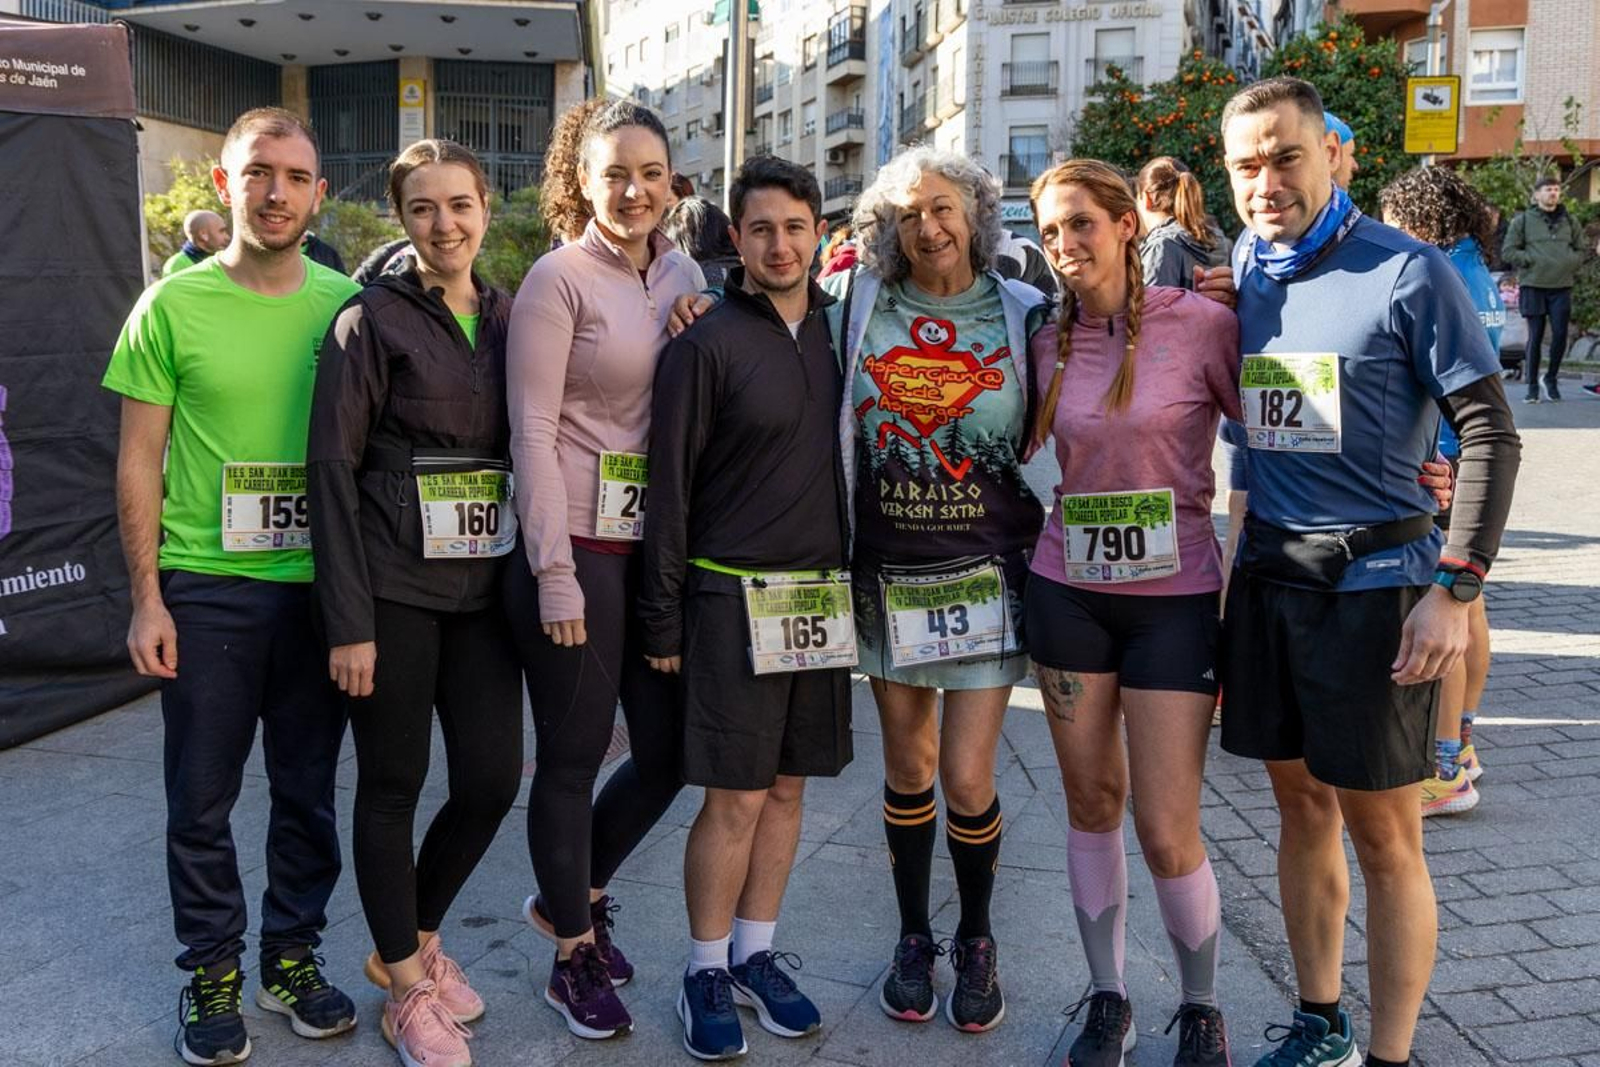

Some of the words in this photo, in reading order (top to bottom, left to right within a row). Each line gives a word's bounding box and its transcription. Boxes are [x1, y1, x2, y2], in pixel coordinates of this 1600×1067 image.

[1044, 6, 1102, 22] COLEGIO
[1108, 2, 1162, 19] OFICIAL
[12, 58, 68, 76] Municipal
[71, 64, 86, 76] de
[9, 72, 25, 85] de
[28, 74, 57, 88] Jaén
[880, 397, 973, 425] Asperger
[1259, 389, 1303, 428] 182
[248, 467, 265, 478] SAN
[267, 467, 288, 478] JUAN
[441, 474, 457, 486] SAN
[459, 474, 478, 485] JUAN
[243, 479, 275, 491] CARRERA
[438, 487, 465, 498] CARRERA
[881, 478, 982, 501] PARAISO
[881, 501, 934, 519] VIRGEN
[940, 503, 985, 519] EXTRA
[1092, 497, 1109, 509] JUAN
[1110, 495, 1133, 508] BOSCO
[259, 495, 309, 530] 159
[455, 502, 499, 537] 160
[1099, 507, 1129, 521] POPULAR
[895, 521, 925, 532] TIENDA
[1083, 525, 1146, 562] 790
[0, 565, 86, 596] miento
[921, 586, 941, 596] JUAN
[927, 603, 969, 638] 43
[780, 615, 827, 651] 165
